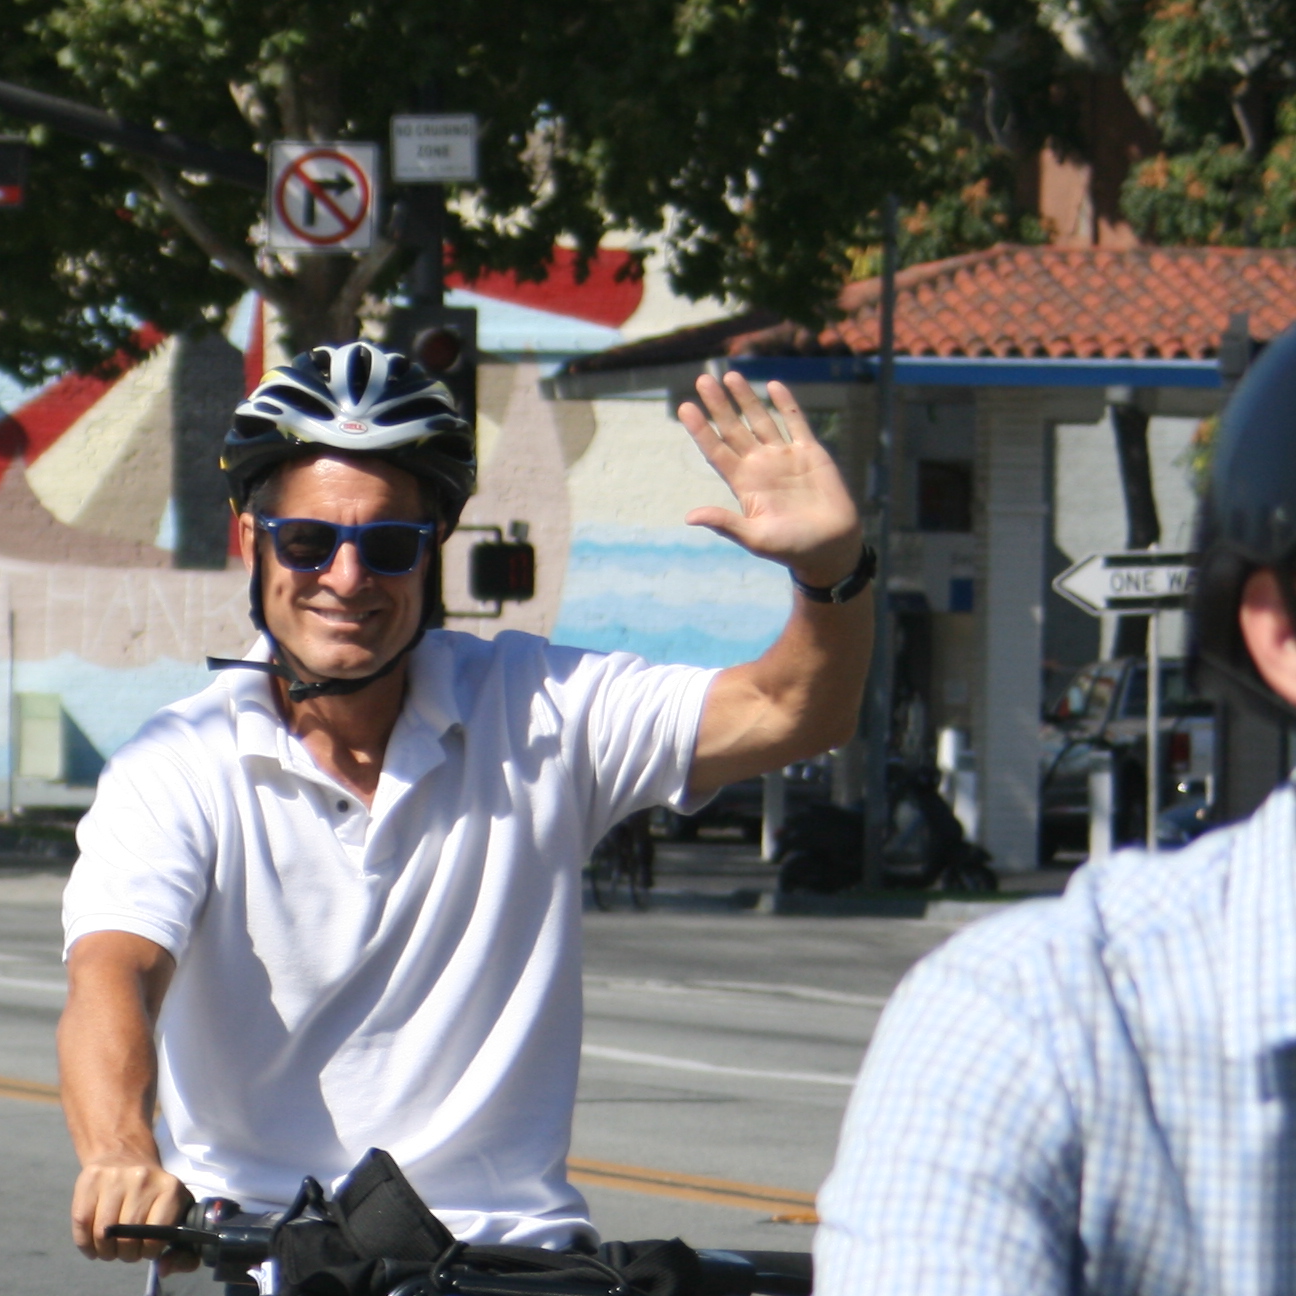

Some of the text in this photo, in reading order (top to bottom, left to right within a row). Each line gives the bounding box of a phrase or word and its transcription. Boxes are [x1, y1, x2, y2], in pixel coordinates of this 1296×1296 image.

[416, 144, 449, 158] ZONE
[1110, 568, 1195, 593] ONE WA
